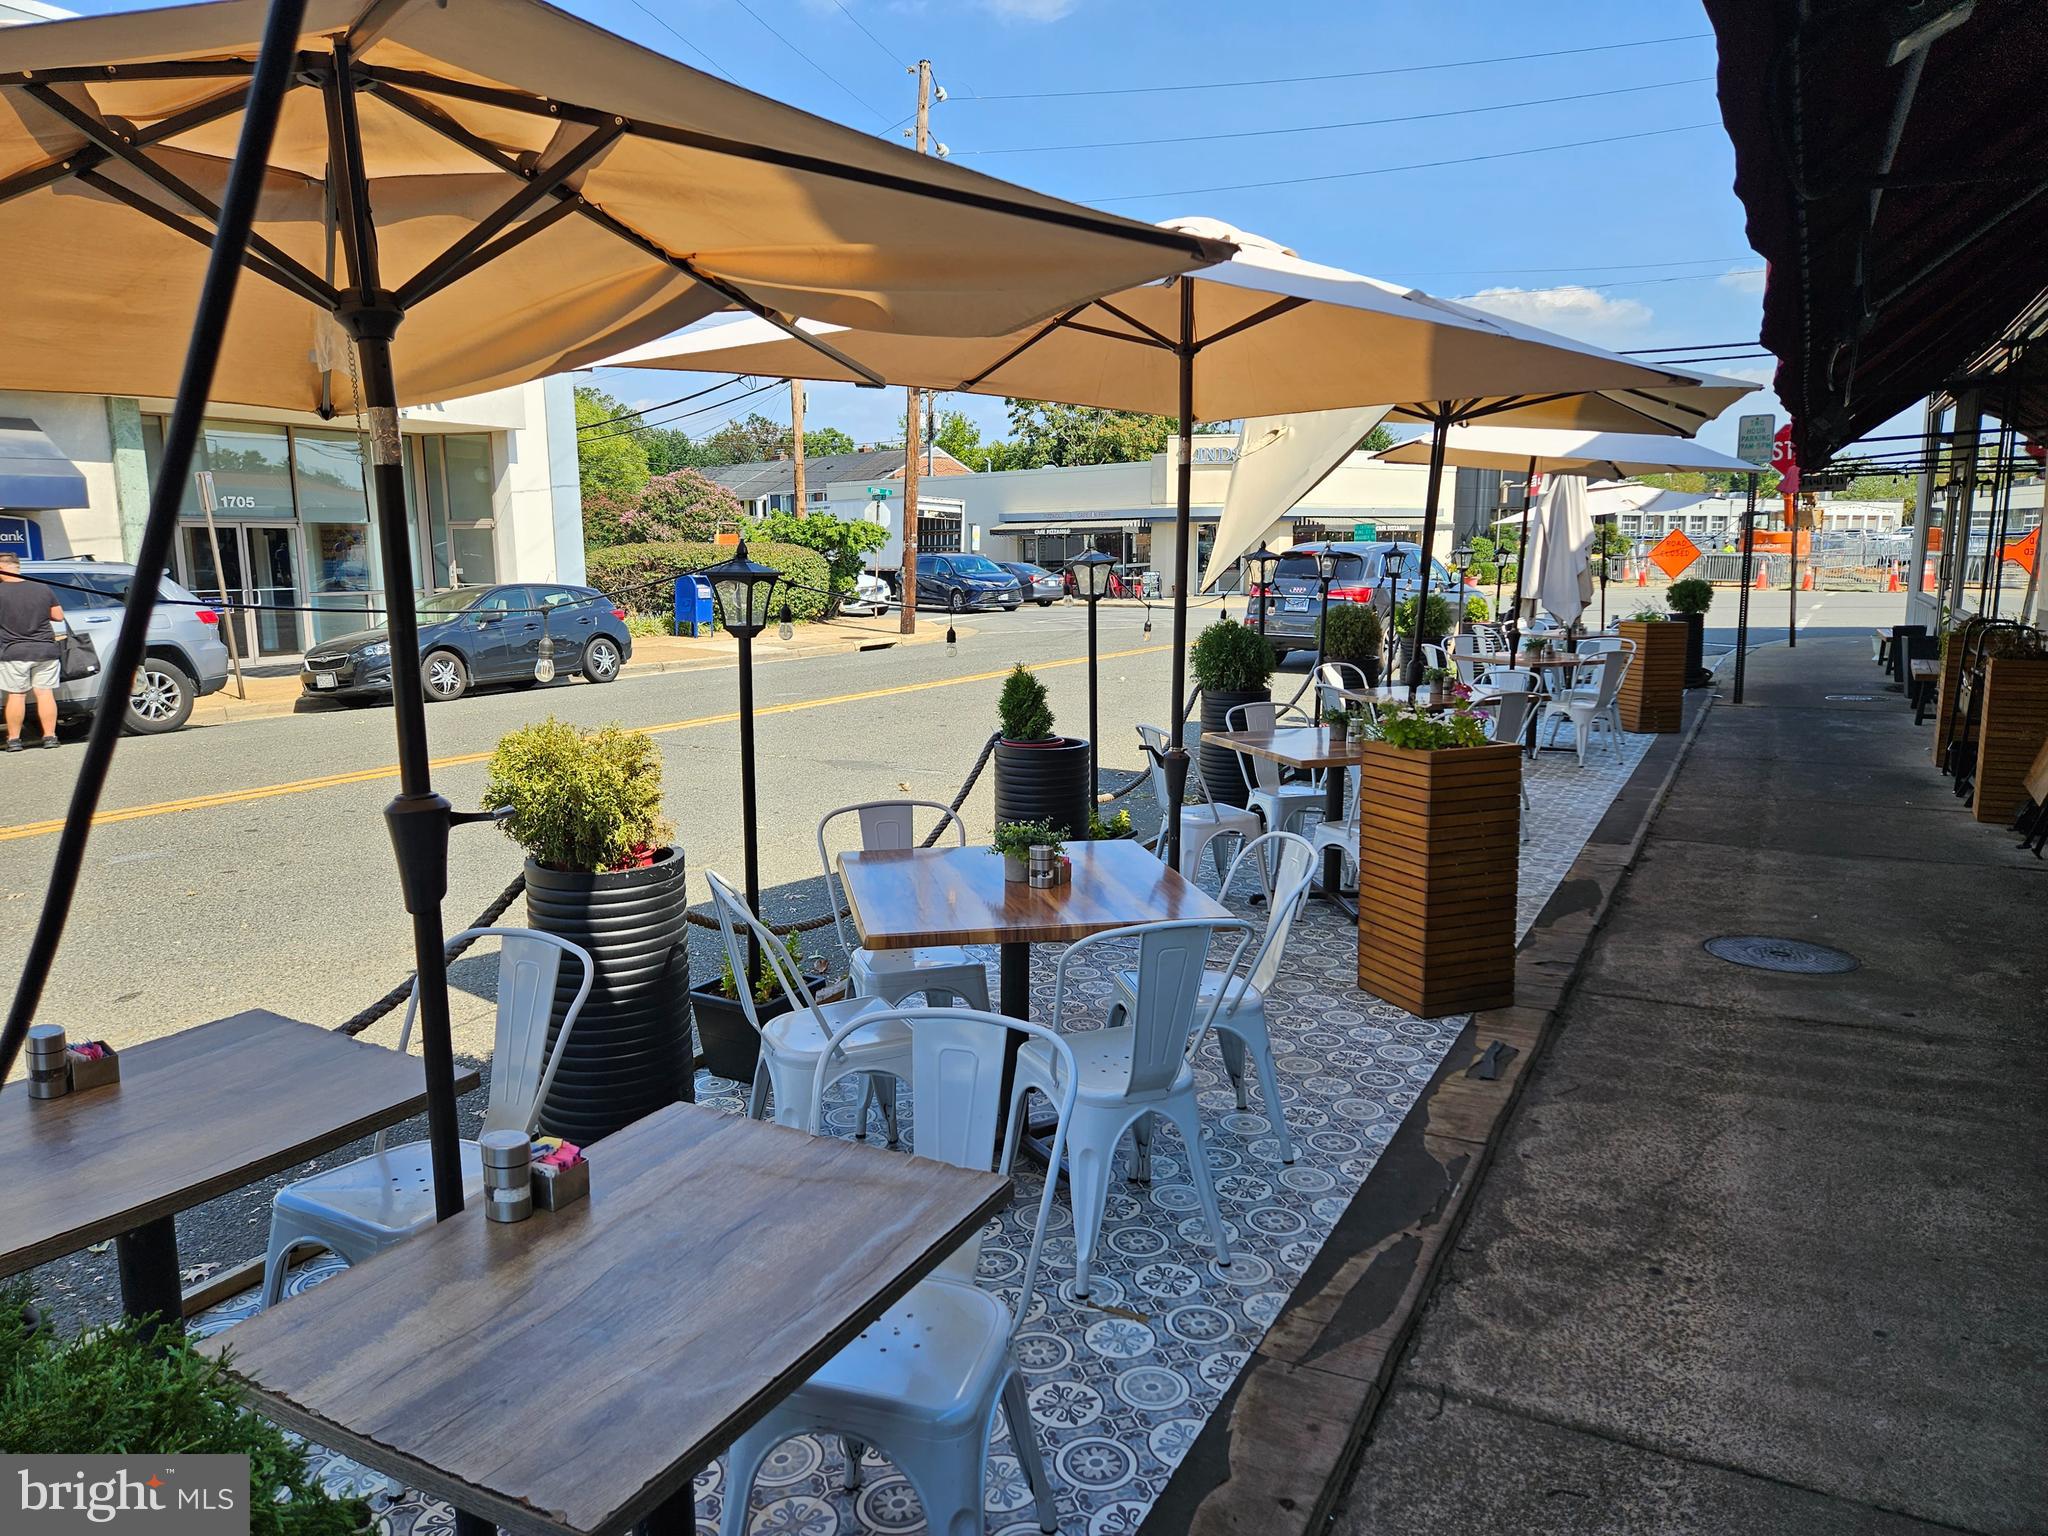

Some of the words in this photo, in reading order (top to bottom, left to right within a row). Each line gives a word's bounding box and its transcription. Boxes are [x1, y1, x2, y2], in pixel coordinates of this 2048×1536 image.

[1772, 441, 1792, 461] ST
[220, 495, 256, 508] 1705
[0, 530, 24, 541] ank
